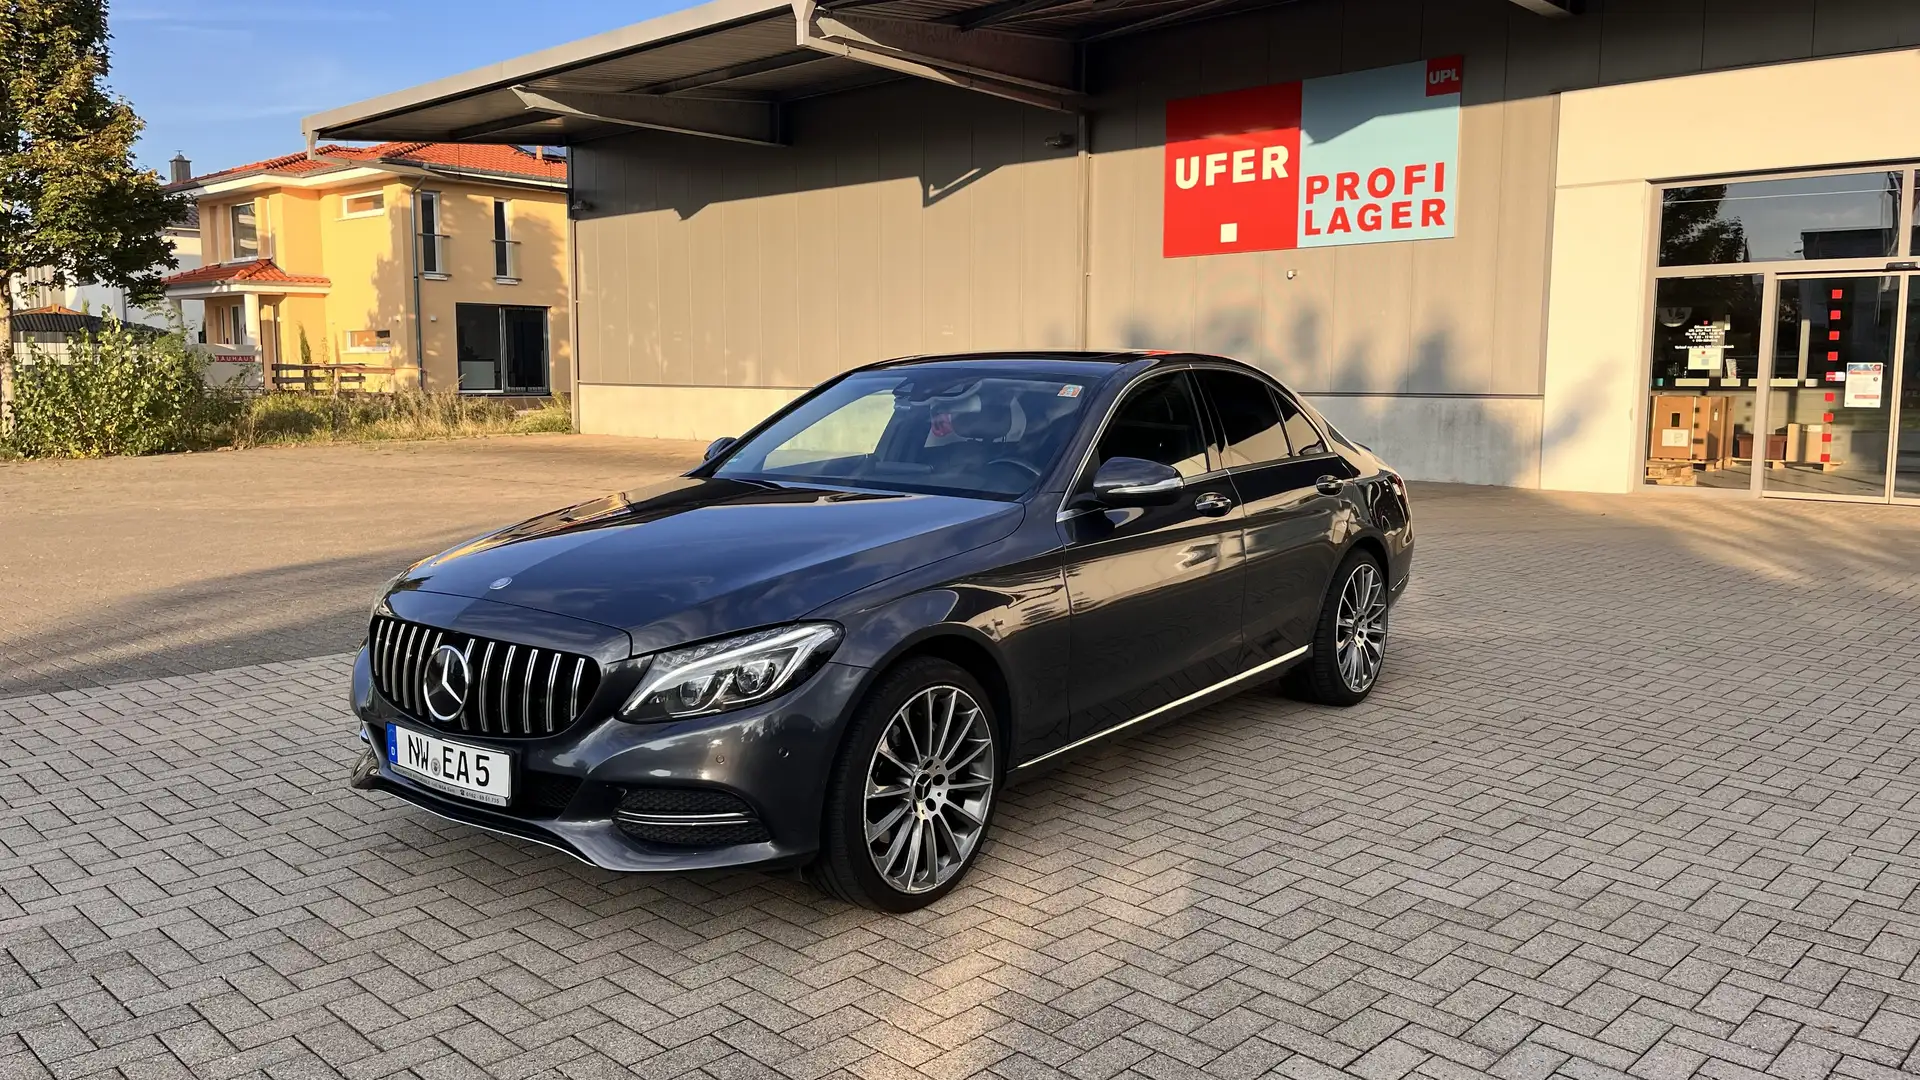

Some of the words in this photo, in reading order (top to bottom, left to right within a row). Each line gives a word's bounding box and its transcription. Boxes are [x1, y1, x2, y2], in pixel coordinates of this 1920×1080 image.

[1429, 69, 1459, 85] UPL
[1175, 145, 1289, 189] UFER
[1305, 162, 1445, 204] PROFI
[1304, 198, 1446, 235] LAGER
[408, 734, 429, 771] NW
